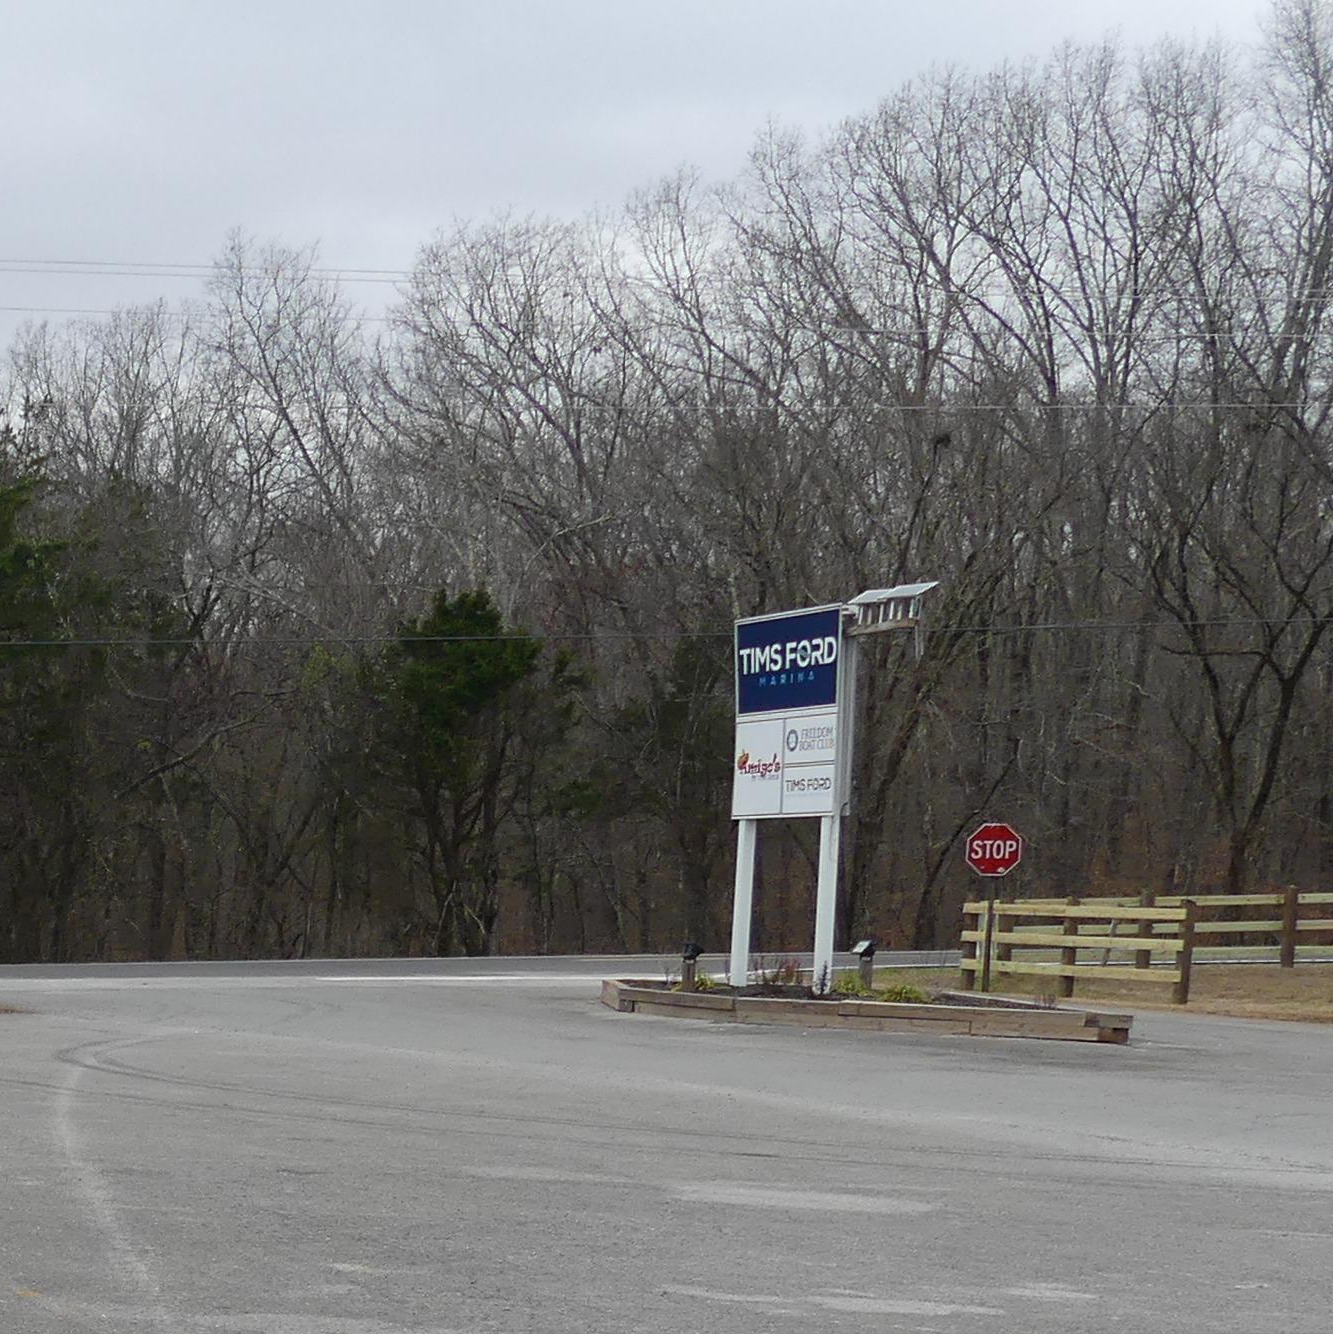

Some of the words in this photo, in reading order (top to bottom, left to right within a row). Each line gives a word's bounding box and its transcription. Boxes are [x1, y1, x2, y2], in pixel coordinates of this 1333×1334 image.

[739, 643, 782, 675] TIMS
[785, 636, 837, 669] FORD
[758, 670, 815, 688] MARINA
[785, 778, 806, 792] TIMS
[807, 777, 831, 791] FORD
[971, 840, 1017, 859] STOP
